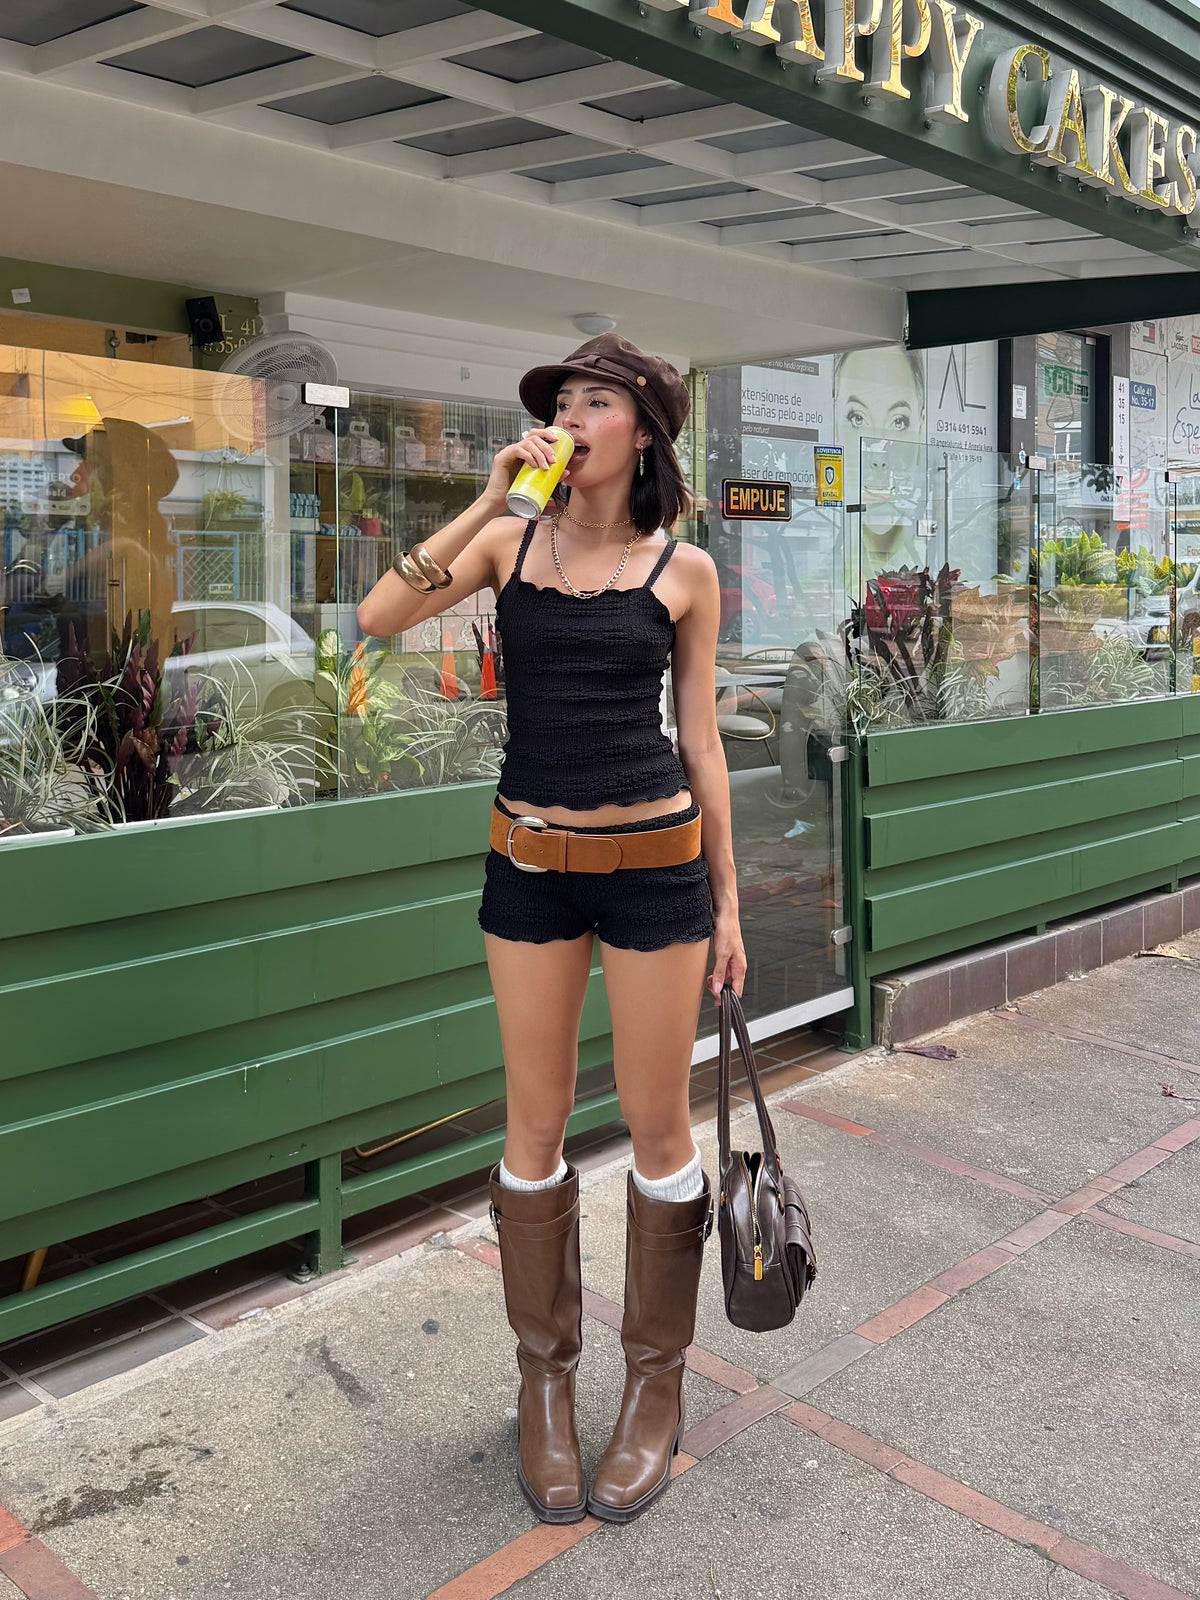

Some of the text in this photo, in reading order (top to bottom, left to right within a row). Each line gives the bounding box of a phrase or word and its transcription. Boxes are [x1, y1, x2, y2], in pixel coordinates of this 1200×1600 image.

[1006, 44, 1197, 215] CAKES
[240, 318, 256, 336] 41
[1118, 382, 1125, 393] 41
[1133, 384, 1153, 398] Calle 41
[741, 387, 802, 406] xtensiones de
[1118, 397, 1125, 409] 35
[1140, 396, 1155, 408] 35-17
[741, 403, 823, 425] estañas pelo a pelo
[1118, 413, 1125, 425] 15
[742, 424, 753, 433] pelo
[944, 421, 987, 436] 314 491 5941
[741, 465, 815, 484] áser de remoción
[730, 487, 786, 512] EMPUJE
